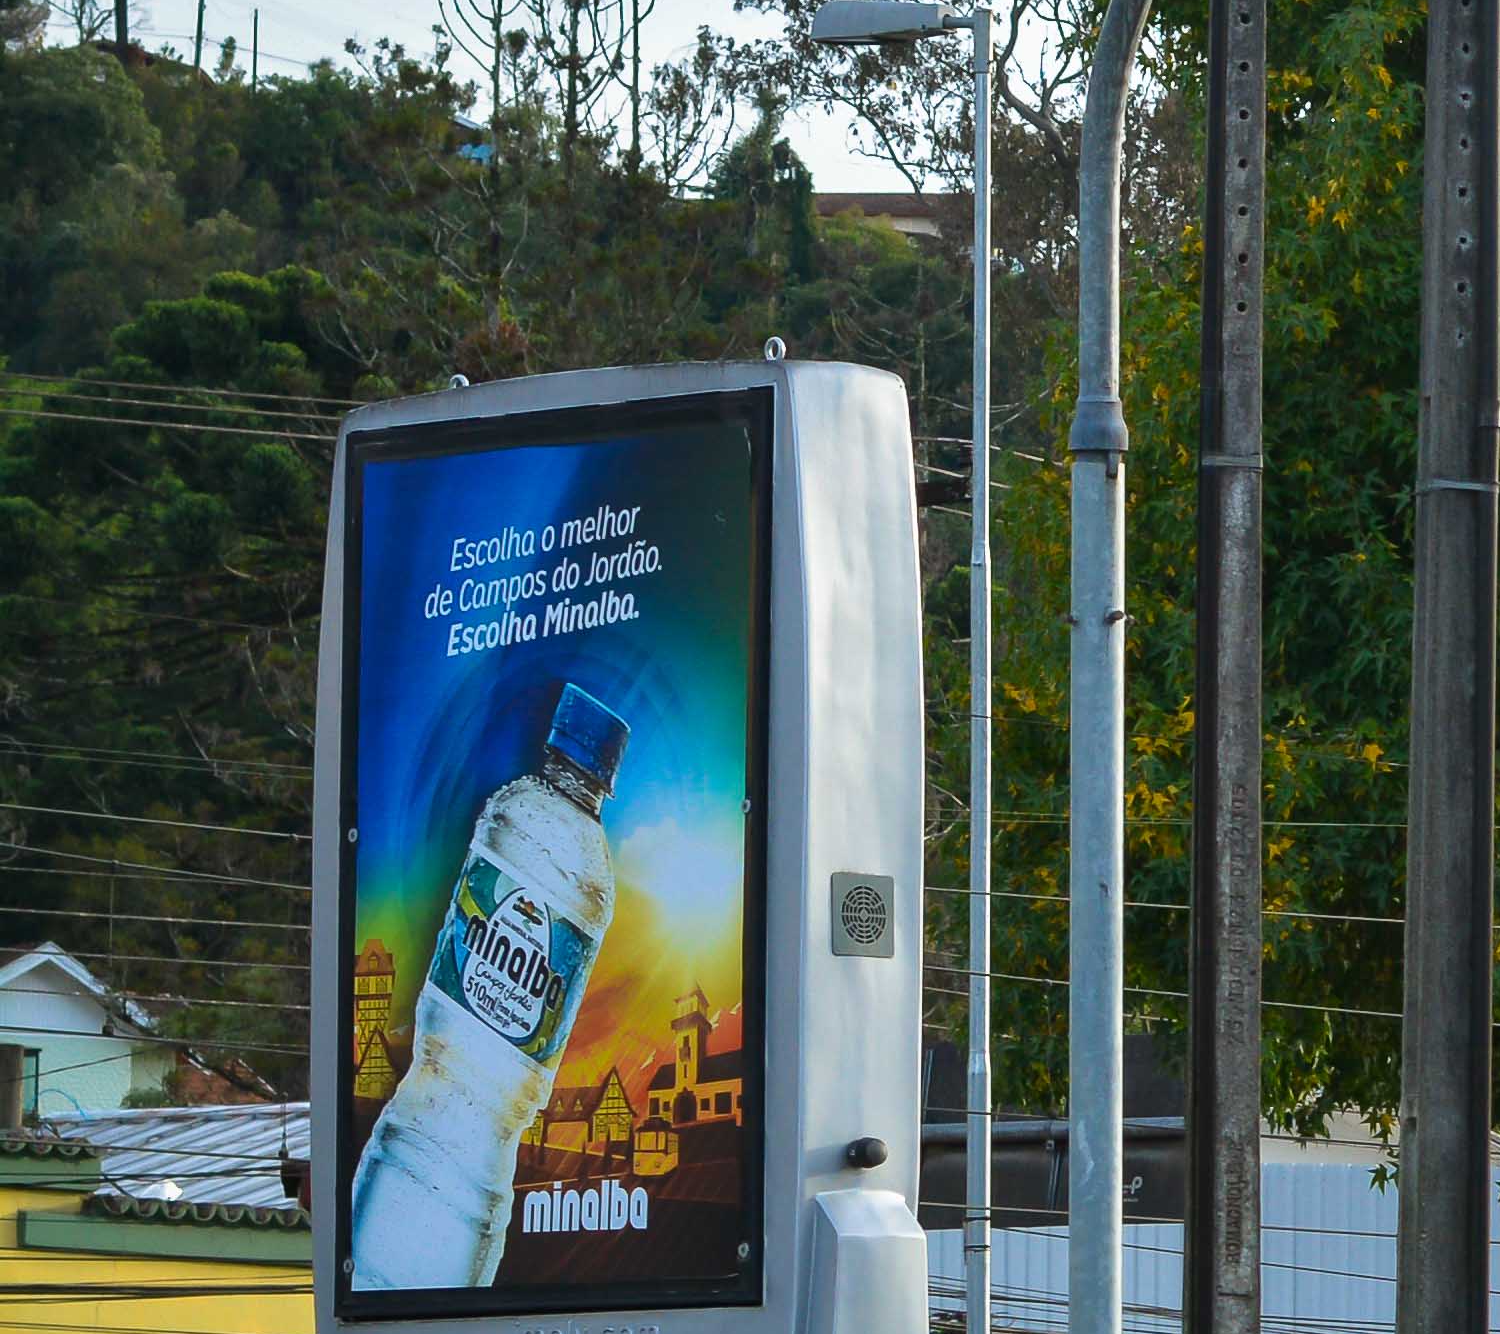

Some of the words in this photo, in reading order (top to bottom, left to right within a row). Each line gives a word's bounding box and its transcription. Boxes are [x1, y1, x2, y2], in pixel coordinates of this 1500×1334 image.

[450, 525, 536, 572] Escolha
[541, 524, 555, 552] o
[560, 504, 641, 548] melhor
[424, 583, 453, 619] de
[459, 569, 547, 612] Campos
[552, 556, 580, 593] do
[584, 539, 662, 586] Jordão.
[447, 611, 537, 657] Escolha
[542, 589, 640, 638] Minalba.
[463, 914, 563, 1009] minalba
[465, 975, 498, 1013] 510ml
[522, 1179, 649, 1234] minalba
